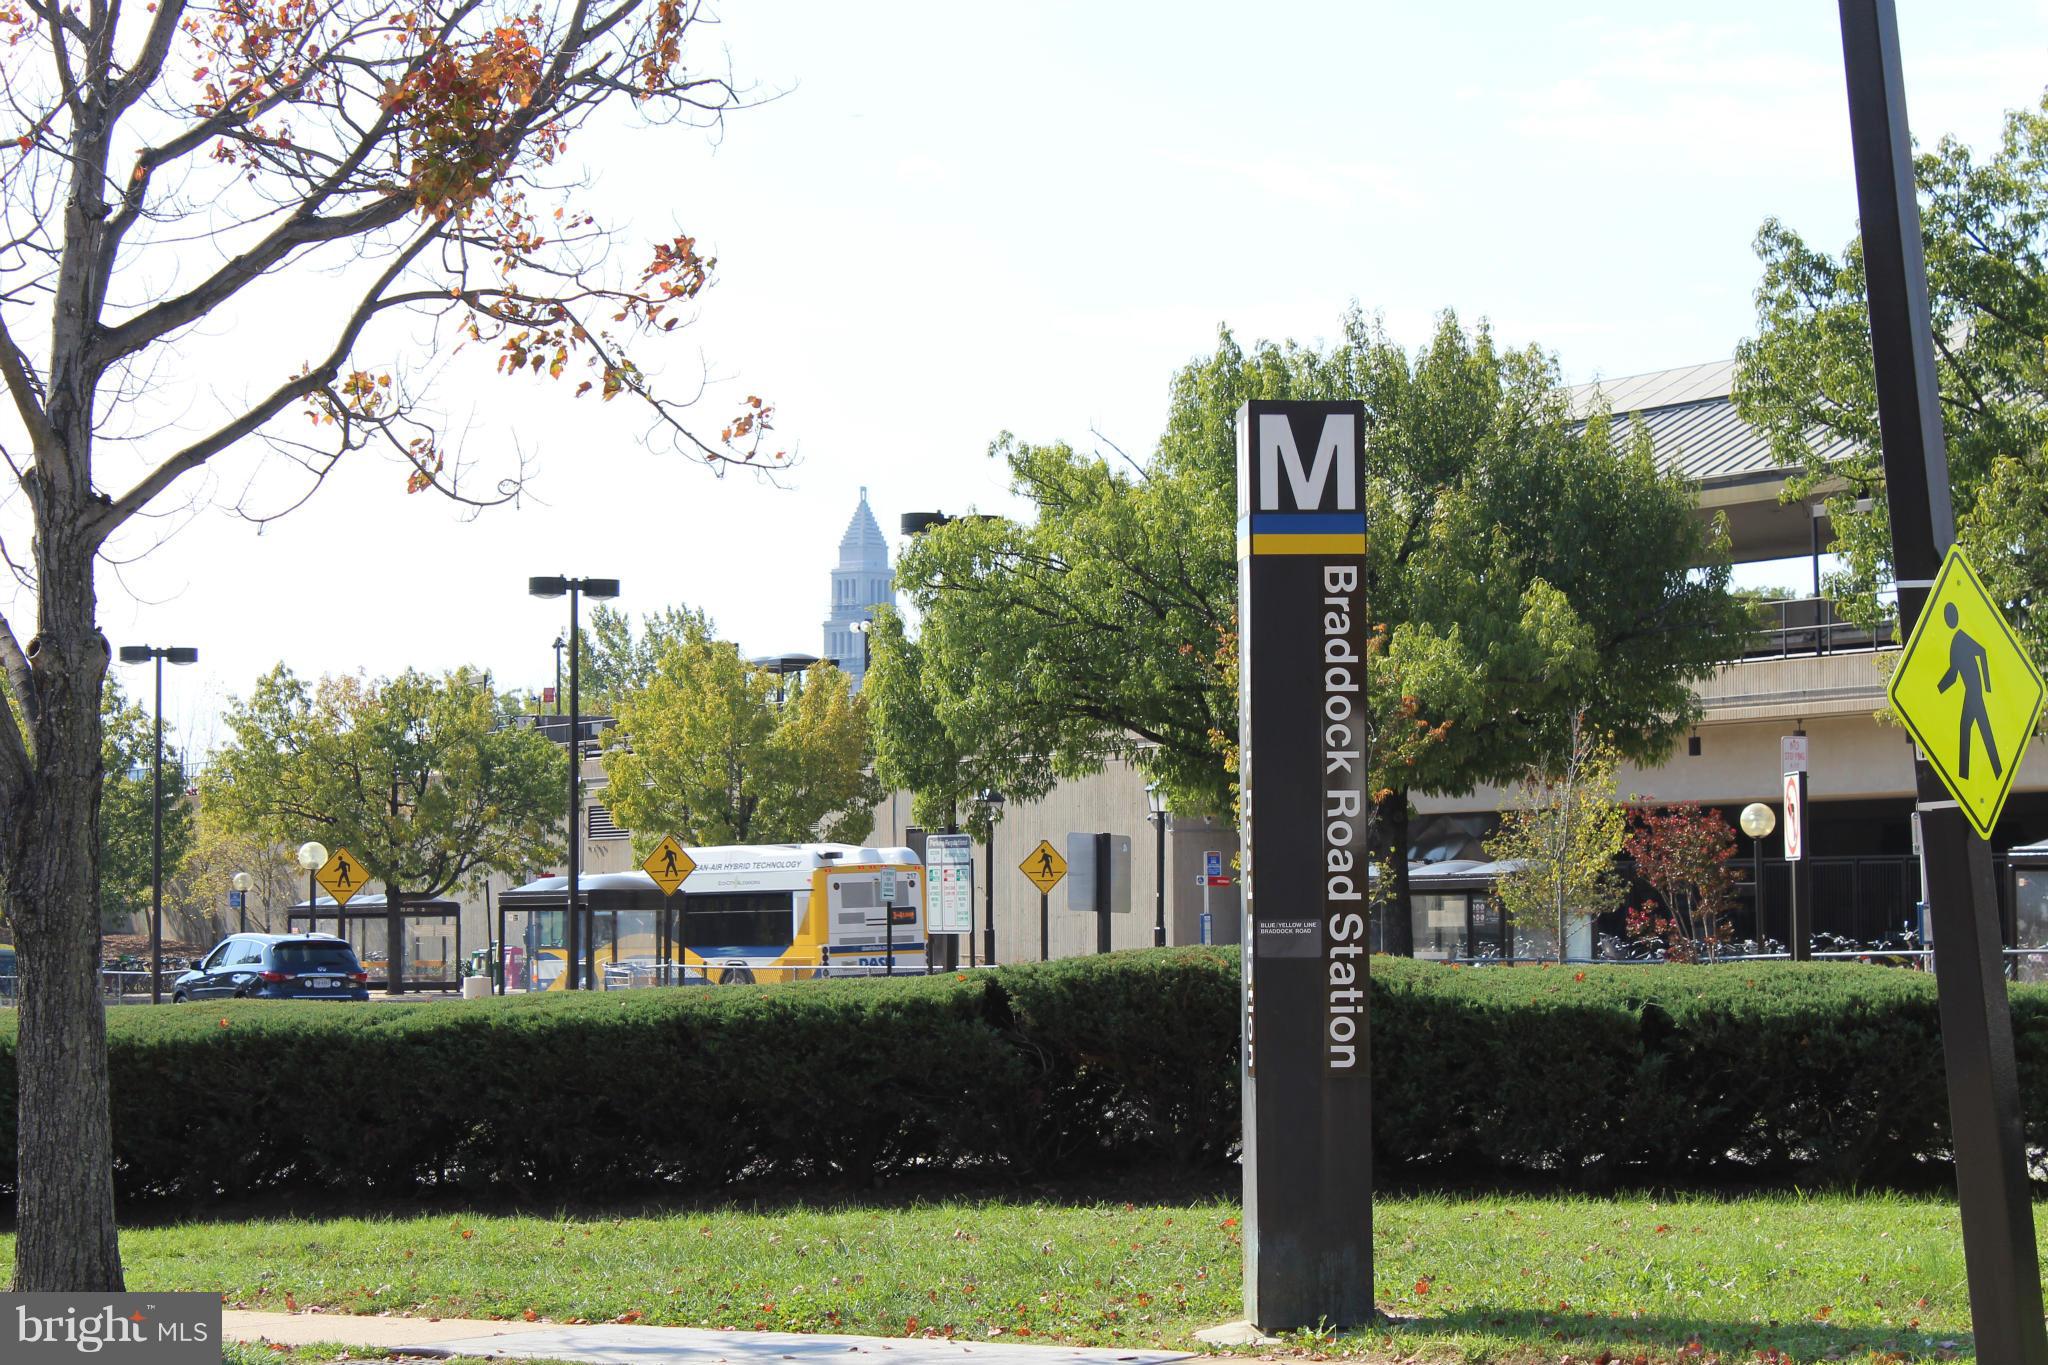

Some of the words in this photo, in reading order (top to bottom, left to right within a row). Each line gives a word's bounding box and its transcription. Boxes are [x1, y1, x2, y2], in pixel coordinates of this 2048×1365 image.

[1259, 414, 1355, 510] M
[1323, 565, 1360, 774] Braddock
[723, 862, 751, 871] HYBRID
[752, 860, 802, 870] TECHNOLOGY
[906, 872, 917, 880] 217
[1326, 790, 1361, 901] Road
[1328, 913, 1363, 1068] Station
